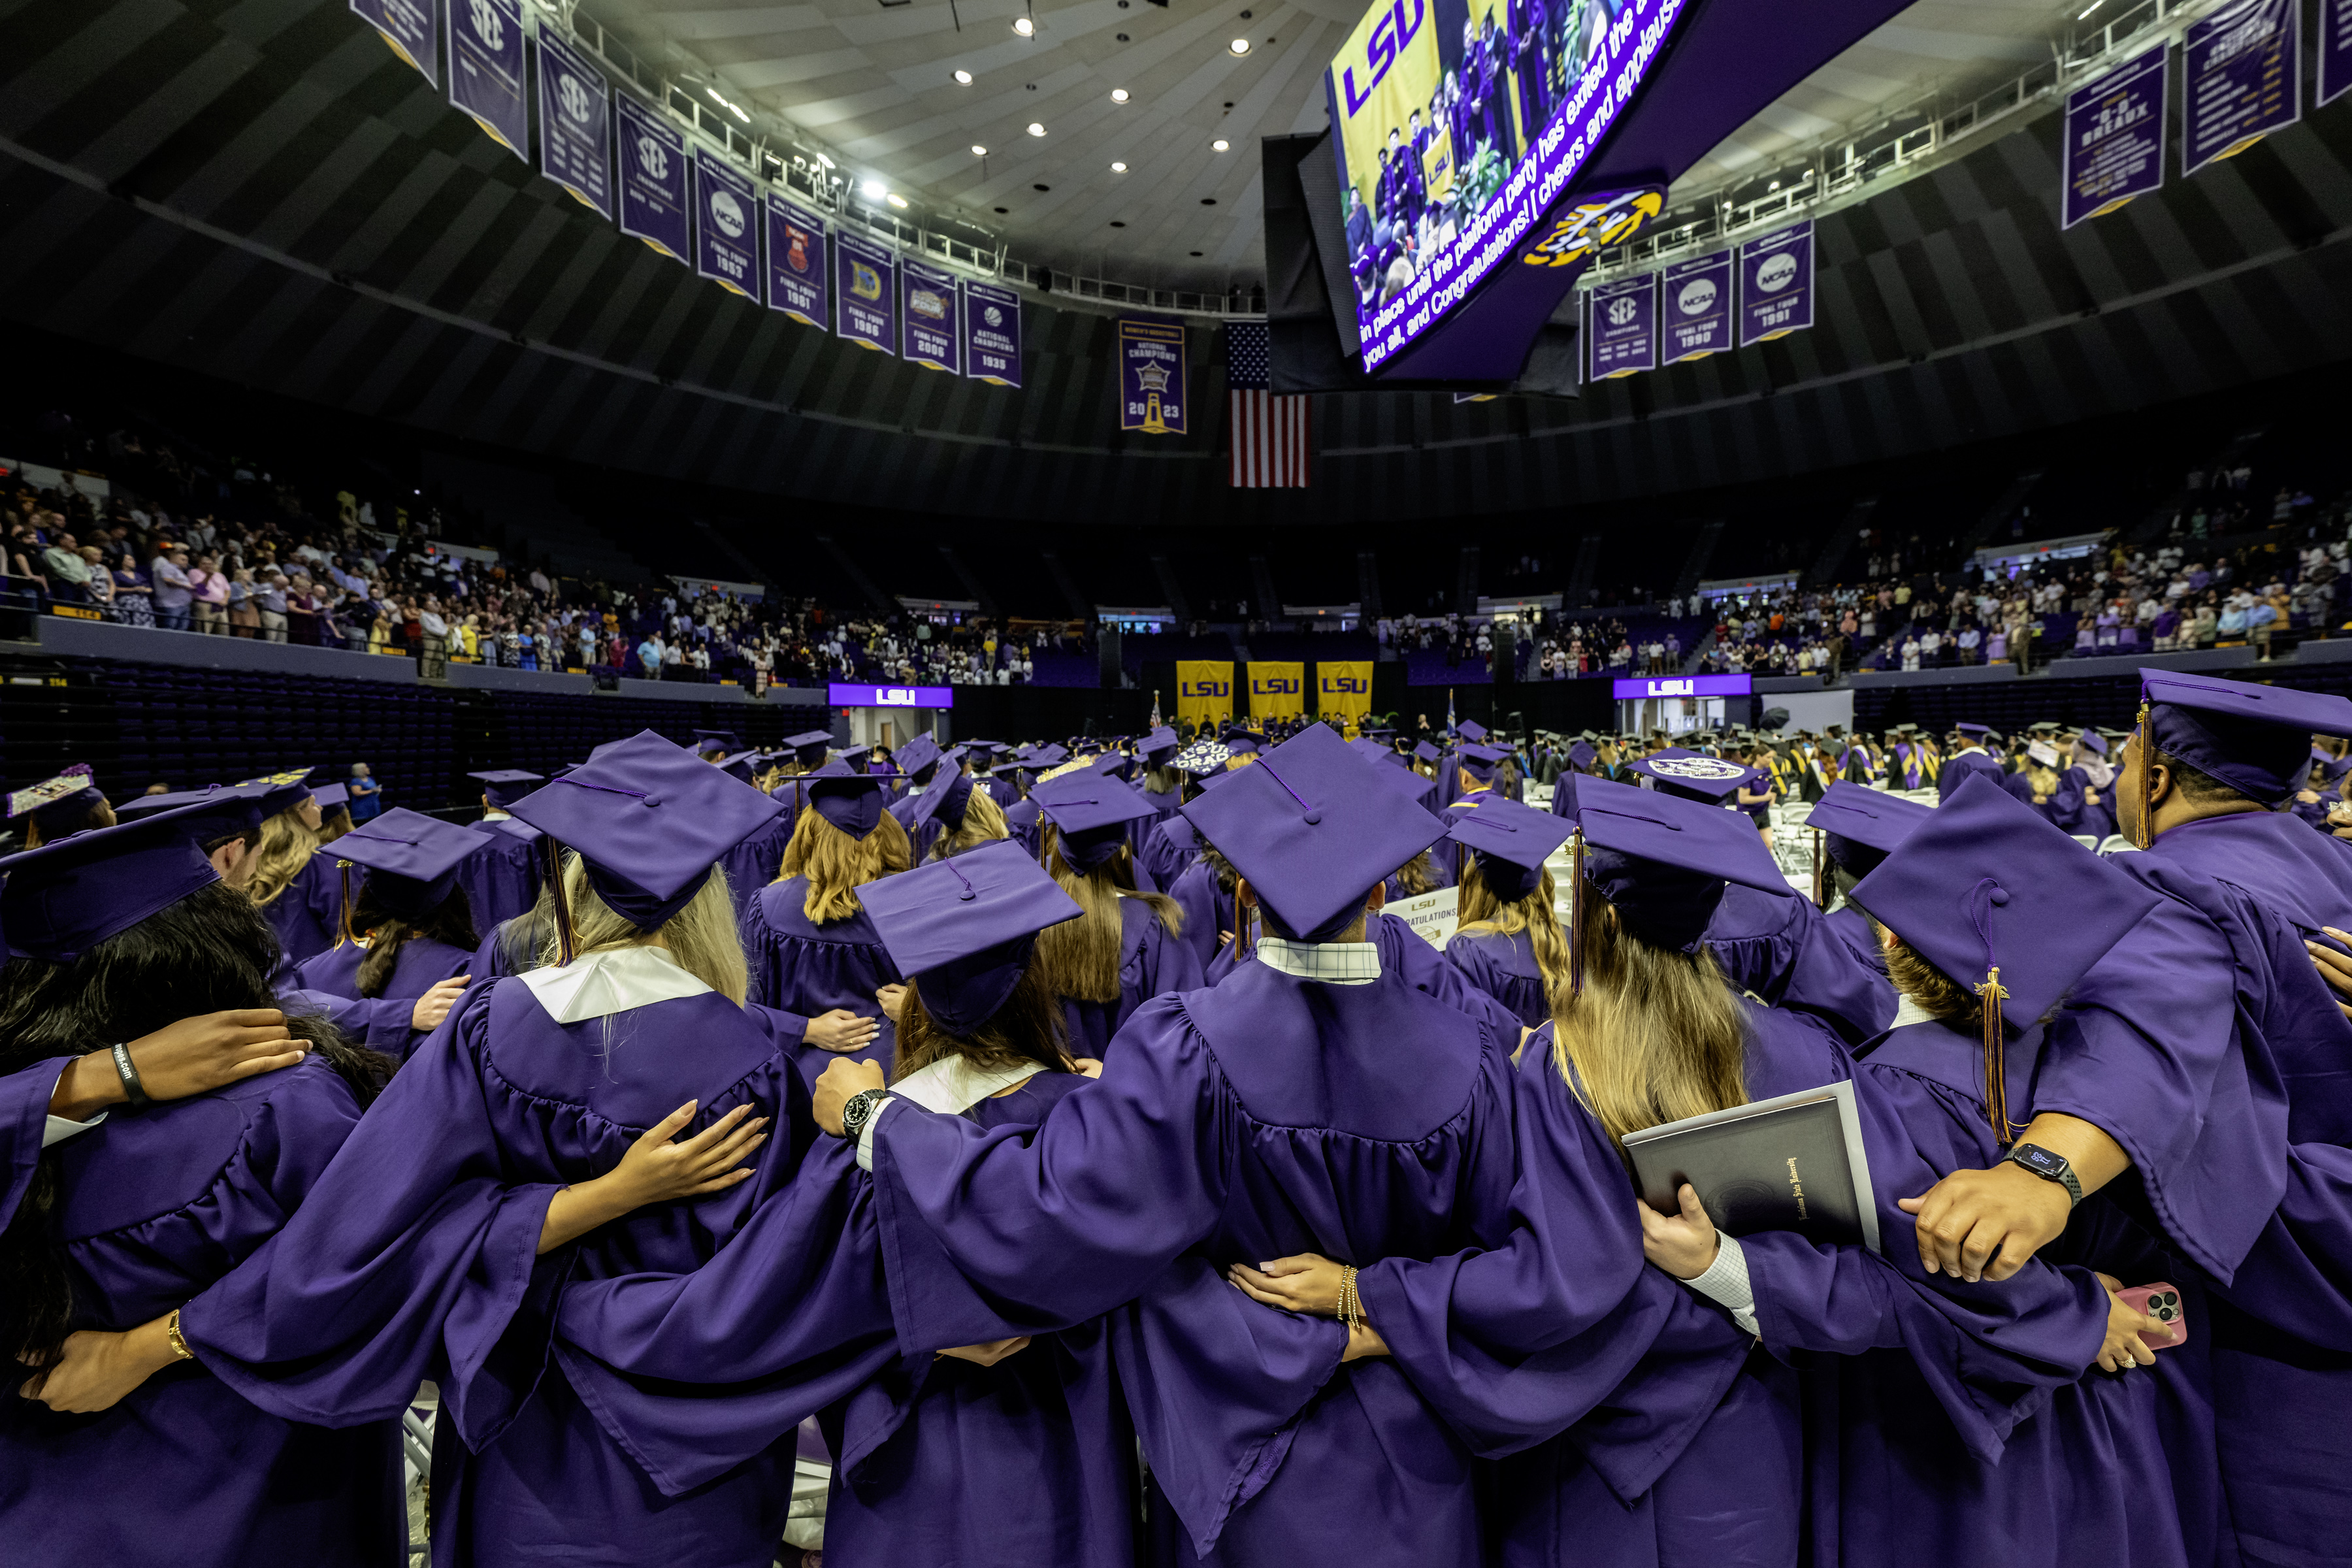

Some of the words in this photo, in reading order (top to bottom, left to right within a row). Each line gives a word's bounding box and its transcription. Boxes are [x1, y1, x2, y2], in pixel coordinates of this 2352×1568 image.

[1343, 0, 1424, 118] LSU
[559, 73, 589, 123] SEC
[2082, 101, 2148, 148] BREAUX
[638, 137, 668, 180] SEC
[1360, 325, 1372, 343] in
[1373, 298, 1405, 338] place
[1407, 268, 1432, 305] until
[1433, 253, 1453, 282] the
[1454, 197, 1505, 267] platform
[1505, 152, 1537, 212] party
[1538, 118, 1565, 163] has
[1567, 43, 1609, 125] exited
[1609, 8, 1634, 59] the
[1428, 150, 1450, 186] LSU
[715, 207, 743, 231] NCAA
[1364, 342, 1386, 372] you
[1387, 325, 1405, 351] all,
[1407, 301, 1430, 336] and
[1431, 199, 1530, 314] Congratulations!
[1539, 135, 1585, 205] cheers
[1586, 85, 1614, 145] and
[711, 240, 729, 259] FINAL
[730, 251, 748, 267] FOUR
[1761, 267, 1797, 286] NCAA
[780, 276, 798, 291] FINAL
[800, 286, 817, 300] FOUR
[787, 290, 810, 309] 1981
[1682, 291, 1716, 308] NCAA
[1754, 304, 1776, 318] FINAL
[1778, 296, 1799, 309] FOUR
[849, 306, 866, 319] FINAL
[1609, 297, 1637, 325] SEC
[1762, 309, 1790, 328] 1991
[977, 329, 1010, 344] NATIONAL
[1676, 325, 1697, 337] FINAL
[1697, 320, 1718, 331] FOUR
[914, 330, 931, 341] FINAL
[932, 336, 949, 346] FOUR
[973, 336, 1015, 352] CHAMPIONS
[1682, 331, 1711, 348] 1990
[1128, 349, 1177, 362] CHAMPIONS
[1129, 402, 1145, 416] 20
[1163, 405, 1179, 418] 23
[1183, 682, 1228, 696] LSU
[1253, 679, 1299, 694] LSU
[1322, 678, 1367, 693] LSU
[1648, 679, 1693, 696] LSU
[876, 689, 915, 706] LSU
[1177, 753, 1229, 768] GRAD
[1181, 744, 1226, 760] LSU
[1411, 899, 1436, 911] LSU
[1786, 1156, 1802, 1184] University
[1793, 1184, 1805, 1197] State
